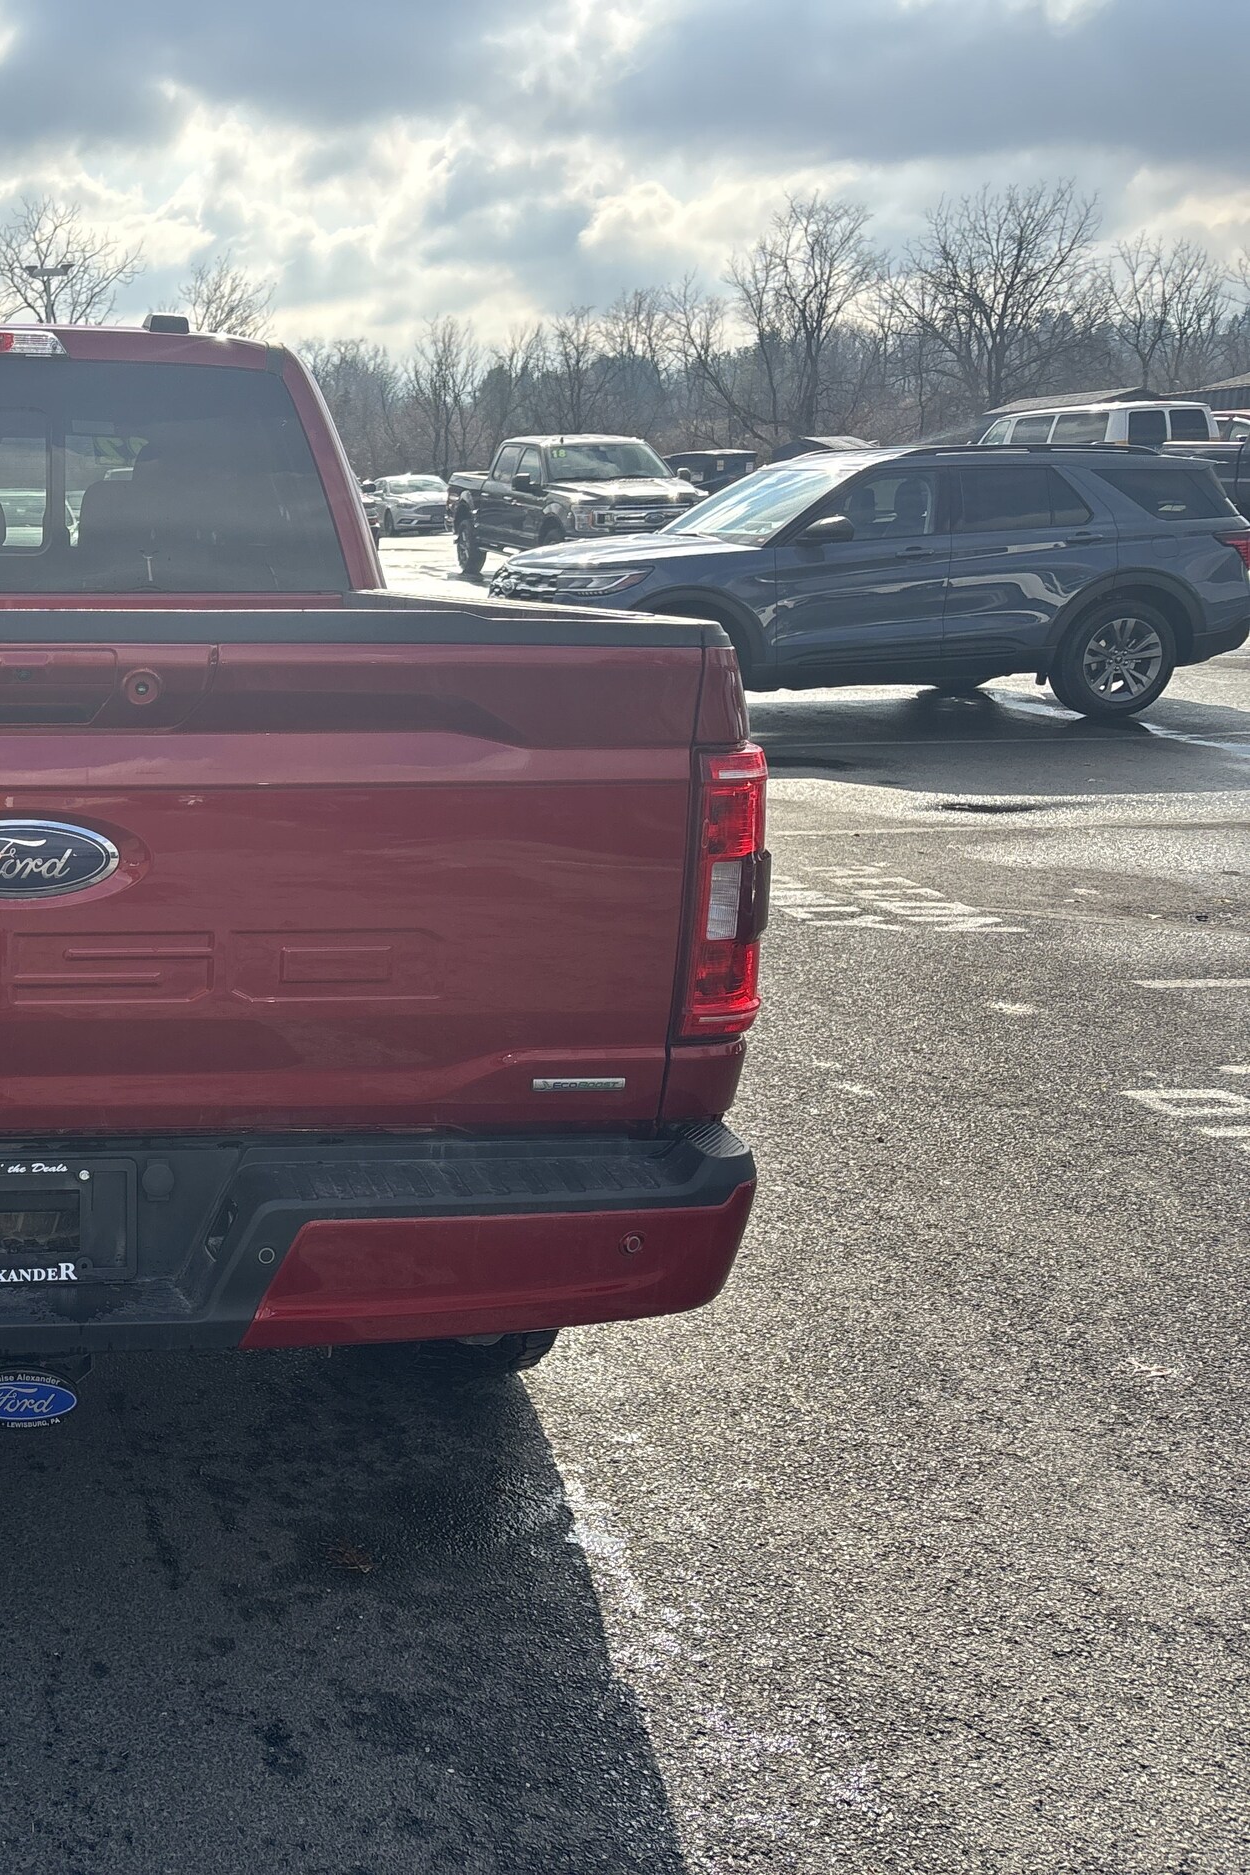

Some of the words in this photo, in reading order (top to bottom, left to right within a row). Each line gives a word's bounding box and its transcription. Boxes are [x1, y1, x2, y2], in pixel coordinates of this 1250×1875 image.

[551, 449, 567, 459] 18
[7, 1163, 27, 1173] the
[31, 1162, 68, 1173] Deals
[16, 1374, 61, 1386] Alexander
[50, 1417, 61, 1425] PA
